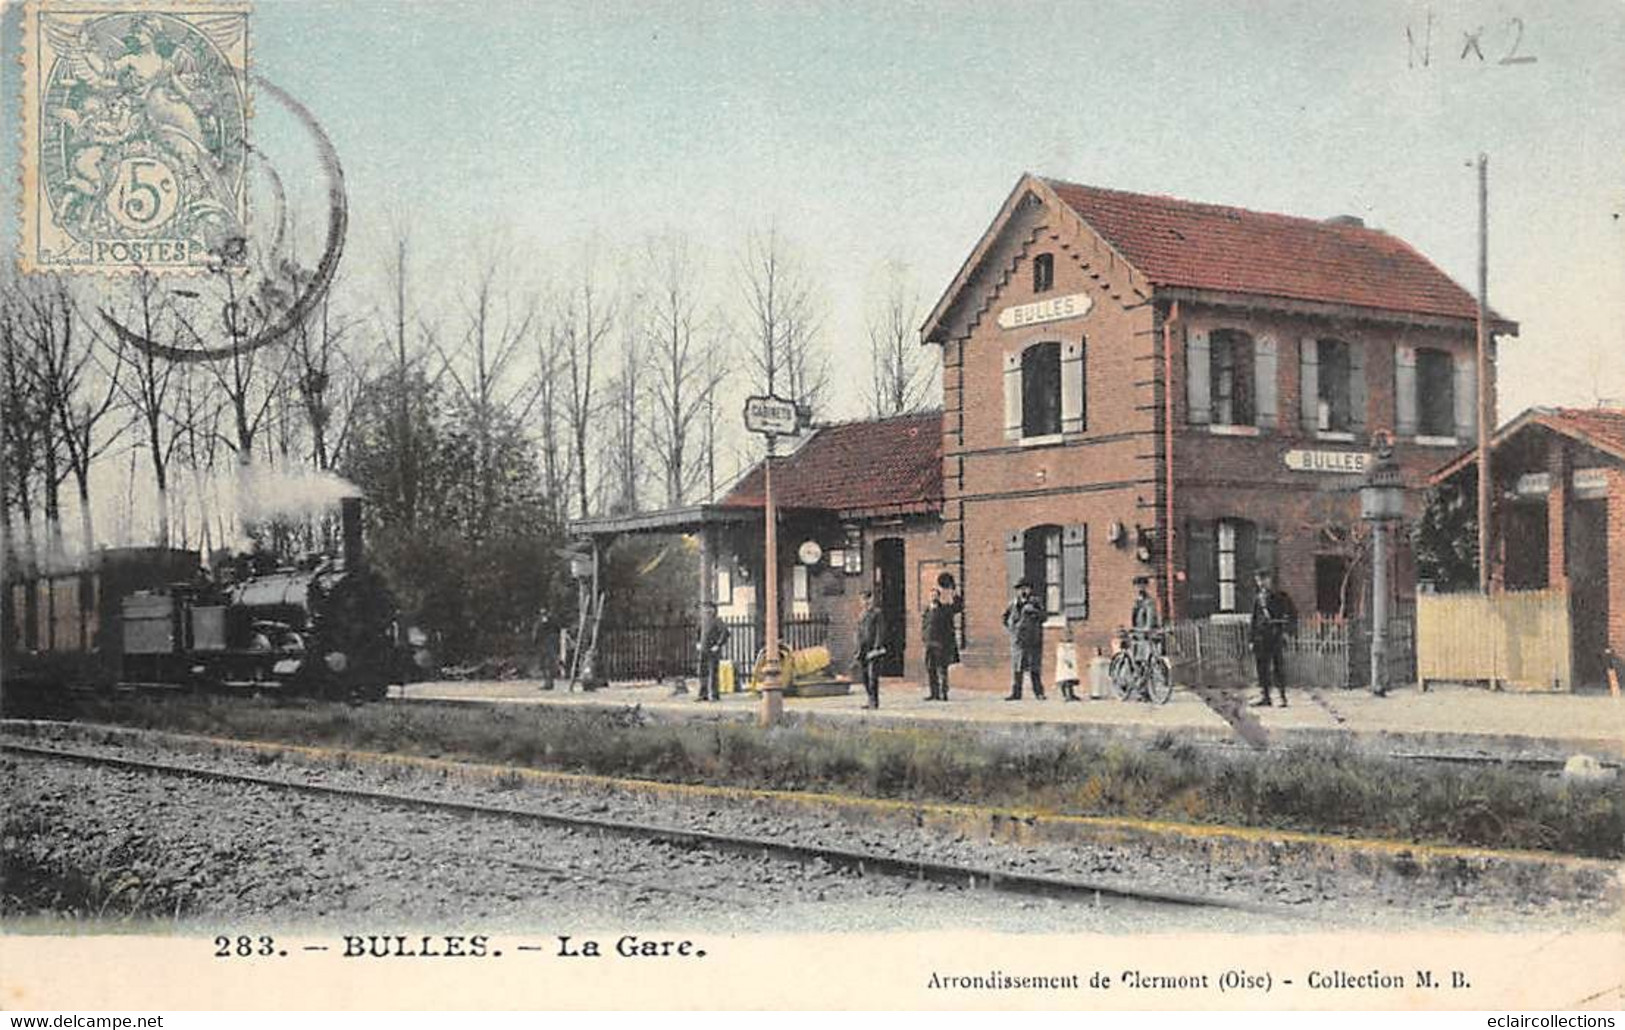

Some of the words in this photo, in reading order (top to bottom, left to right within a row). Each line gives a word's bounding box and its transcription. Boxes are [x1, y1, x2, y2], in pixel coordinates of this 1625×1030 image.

[1498, 17, 1537, 65] 2
[96, 242, 186, 263] POSTES
[1014, 299, 1074, 323] BULLES
[1302, 452, 1364, 470] BULLES
[214, 936, 288, 957] 283.
[343, 935, 502, 957] BULLES.
[557, 935, 600, 957] La
[616, 935, 706, 957] Gare.
[927, 971, 1079, 989] Arrondissement
[1089, 971, 1111, 989] de
[1218, 970, 1272, 993] (Oise)
[1307, 970, 1404, 989] Collection
[1415, 971, 1439, 989] M.
[1452, 971, 1471, 989] B.
